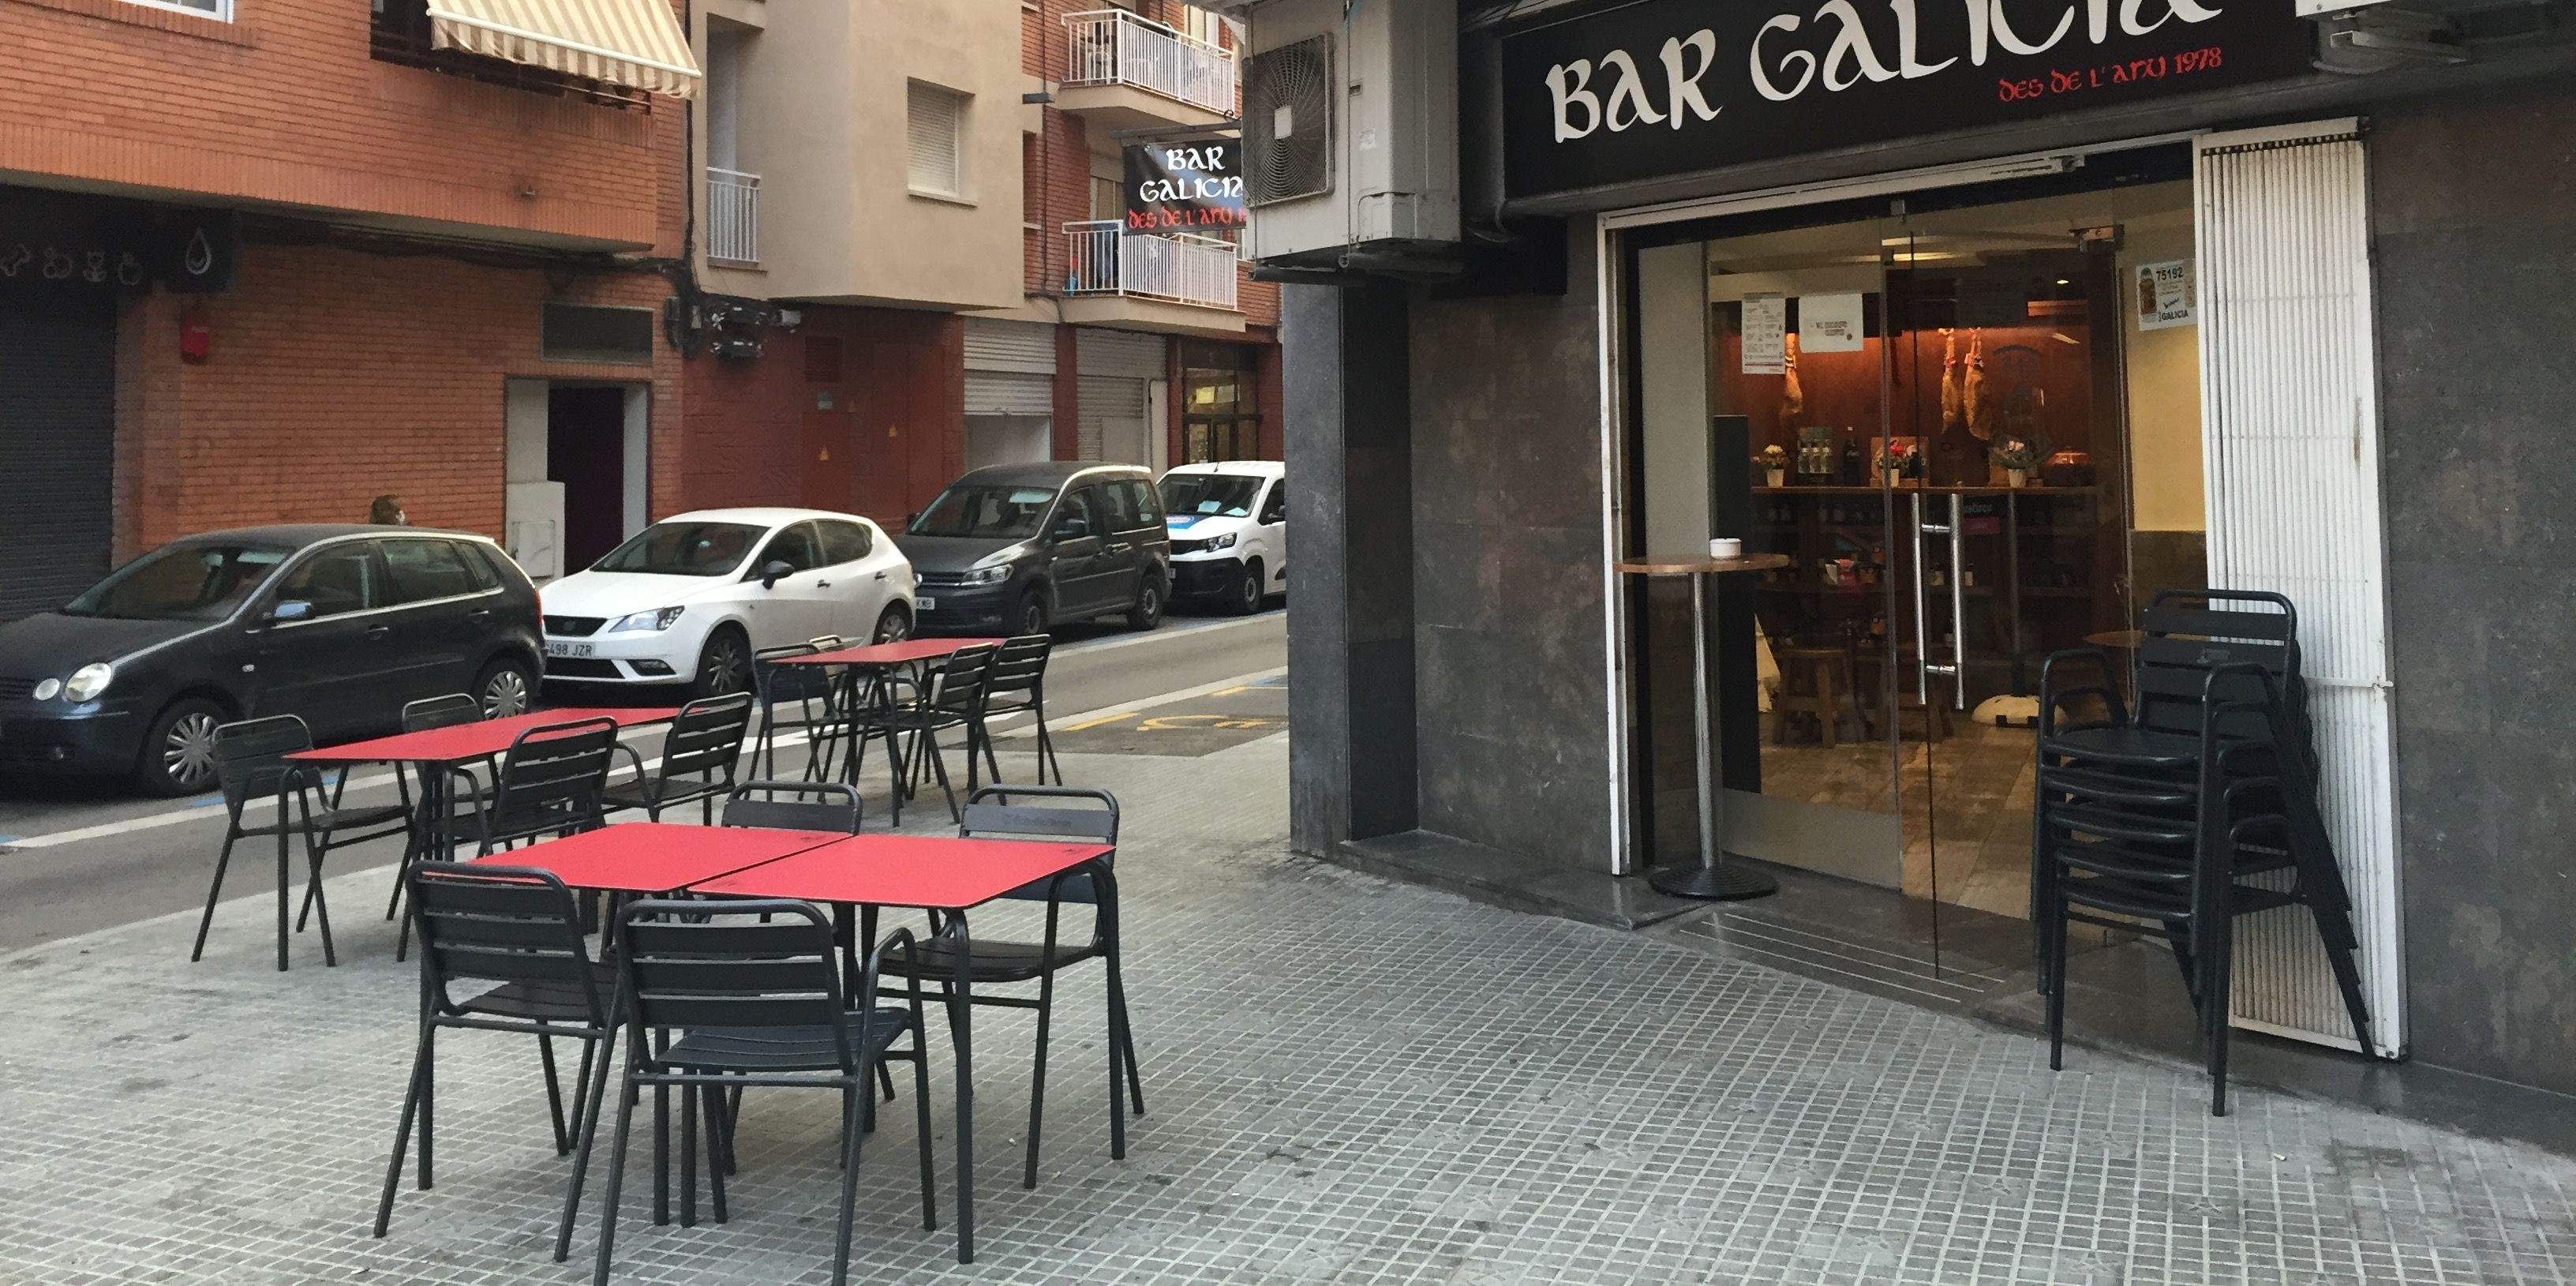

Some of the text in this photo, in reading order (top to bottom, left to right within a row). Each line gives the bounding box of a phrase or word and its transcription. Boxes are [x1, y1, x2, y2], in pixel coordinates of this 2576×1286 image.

[2174, 47, 2222, 74] 1978
[1544, 29, 1724, 144] BAR
[1166, 146, 1226, 171] BAR
[1139, 175, 1244, 203] GALICIA
[2155, 267, 2185, 282] 75192
[2161, 309, 2189, 322] GALICIA
[547, 643, 593, 657] 498 JZR
